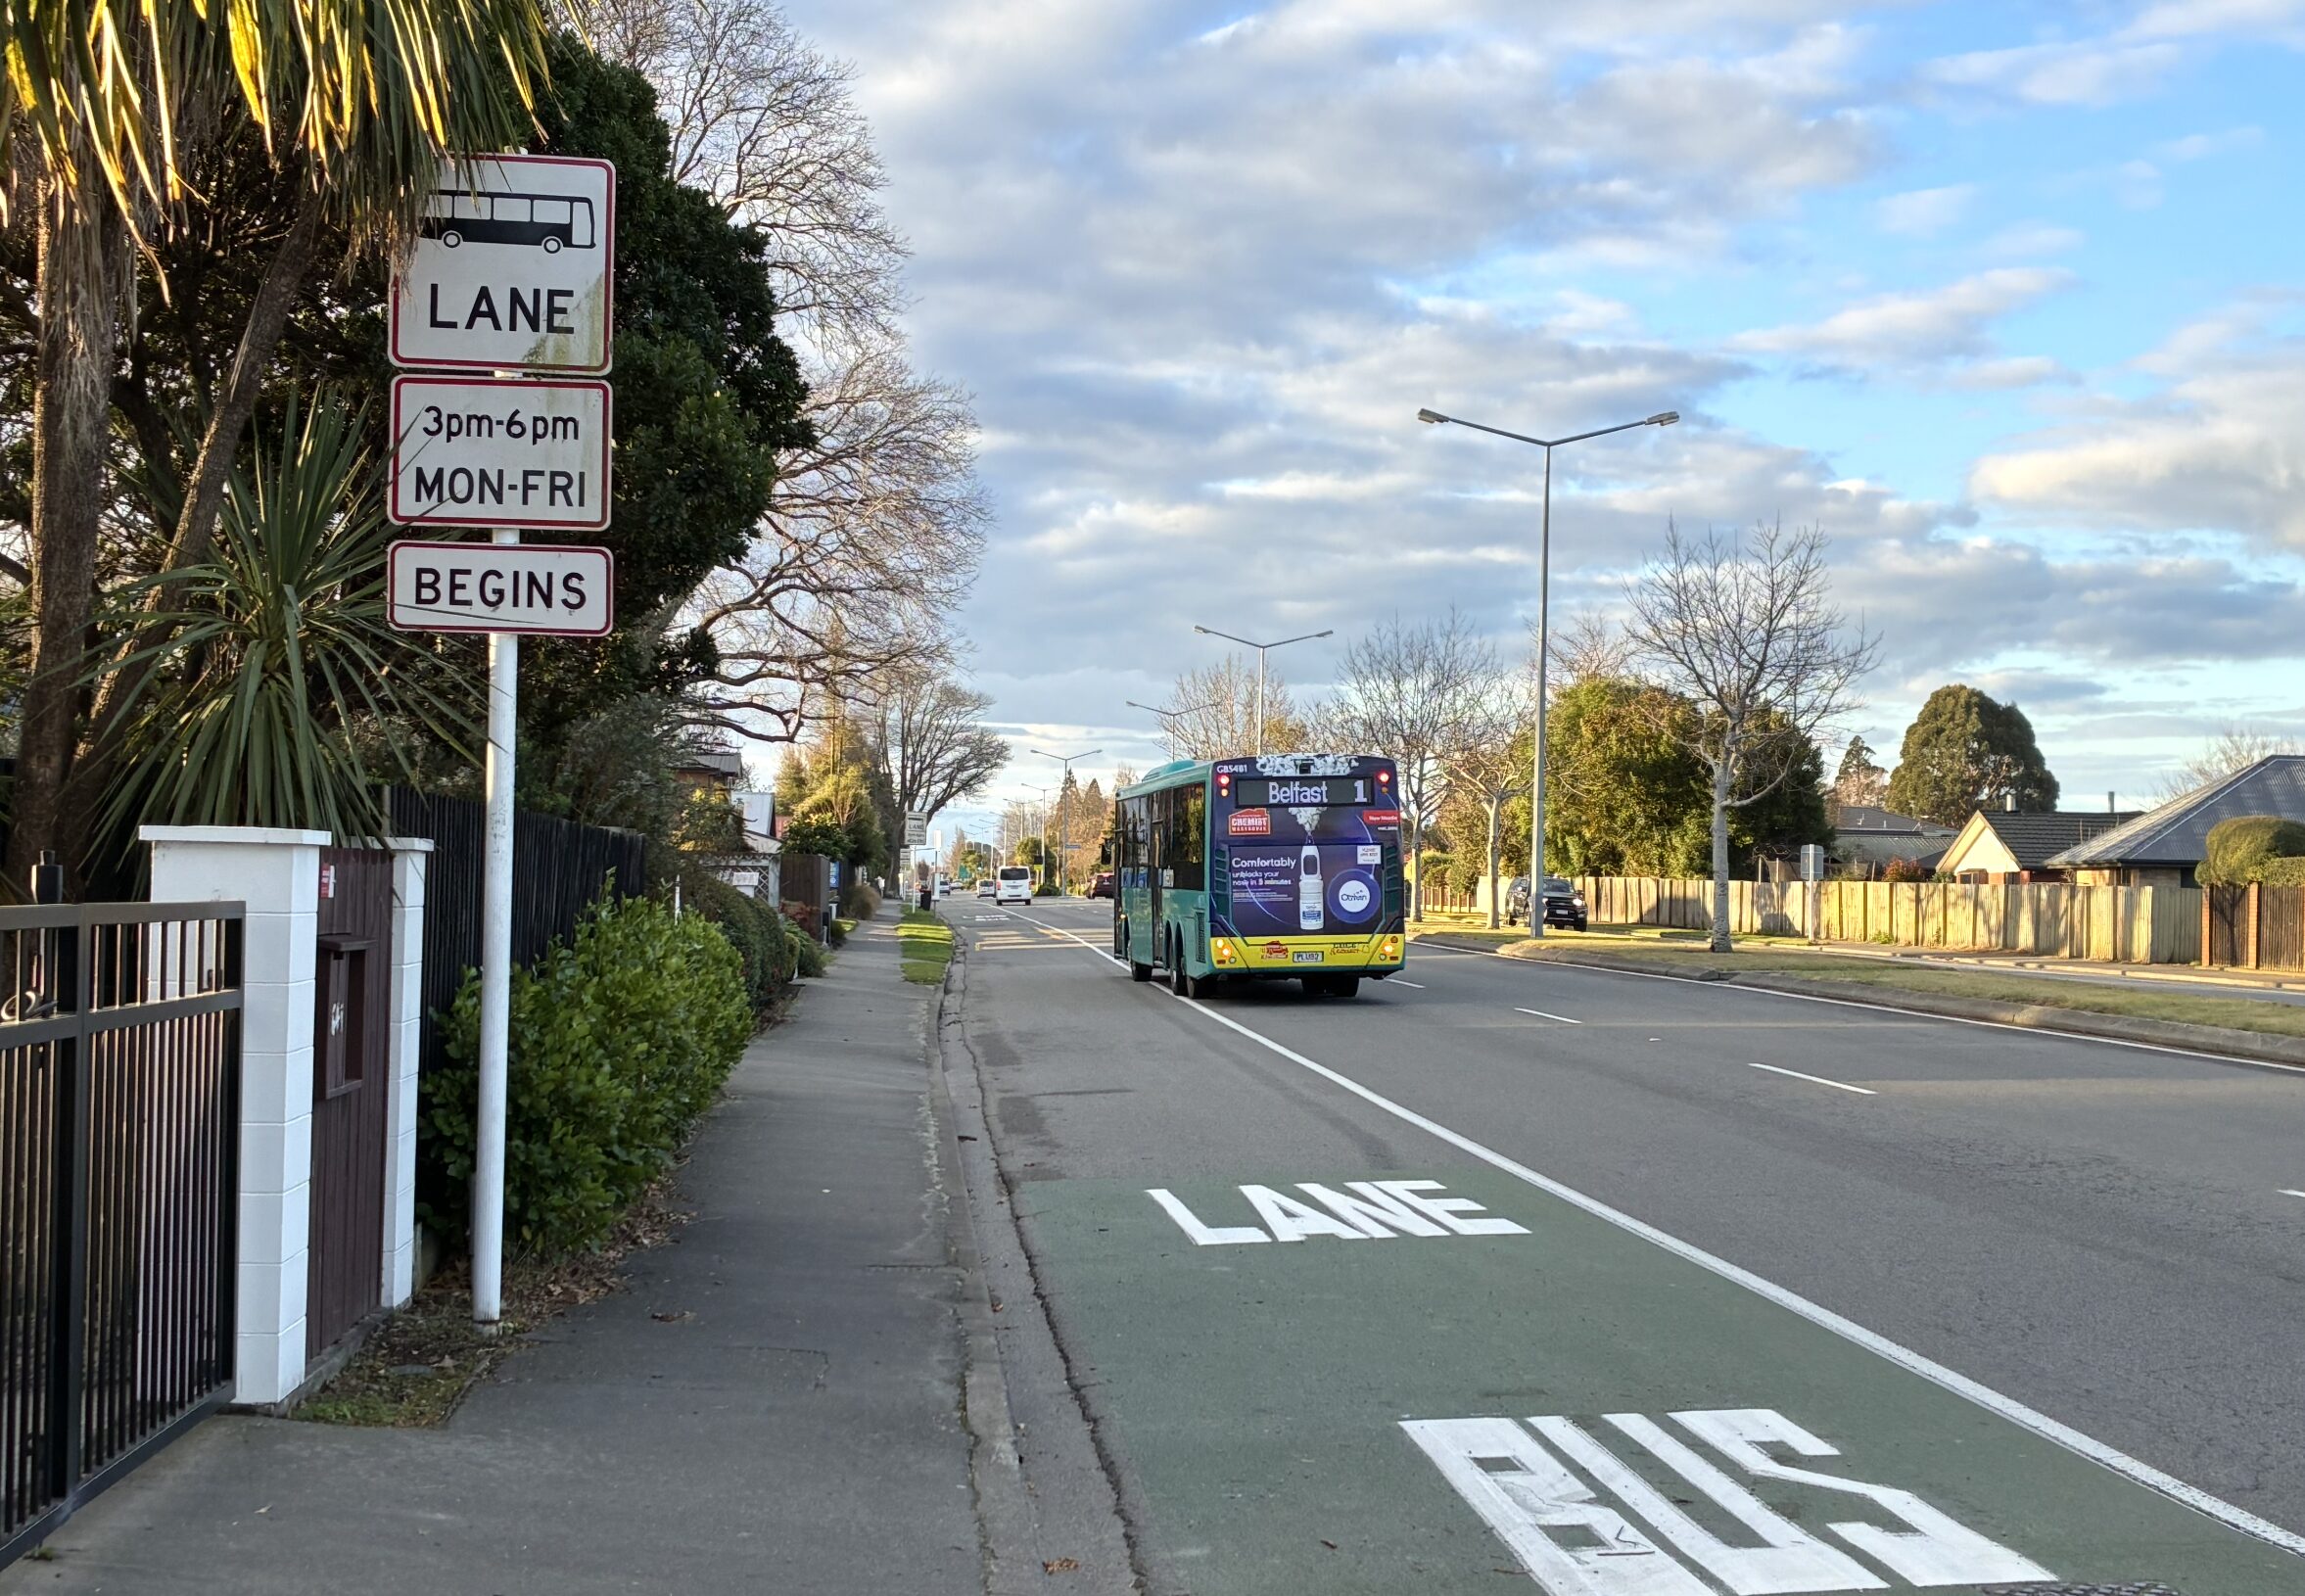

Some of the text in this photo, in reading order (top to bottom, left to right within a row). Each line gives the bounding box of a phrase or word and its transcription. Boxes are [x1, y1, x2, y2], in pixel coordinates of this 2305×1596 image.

[429, 283, 575, 335] LANE
[422, 404, 580, 446] 3pm-6pm
[414, 465, 586, 508] MON-FRI
[414, 566, 588, 610] BEGINS
[1268, 779, 1368, 804] Belfast 1
[1232, 856, 1296, 869] Comfortably
[1144, 1179, 1533, 1245] LANE
[1398, 1407, 2059, 1596] BUS
